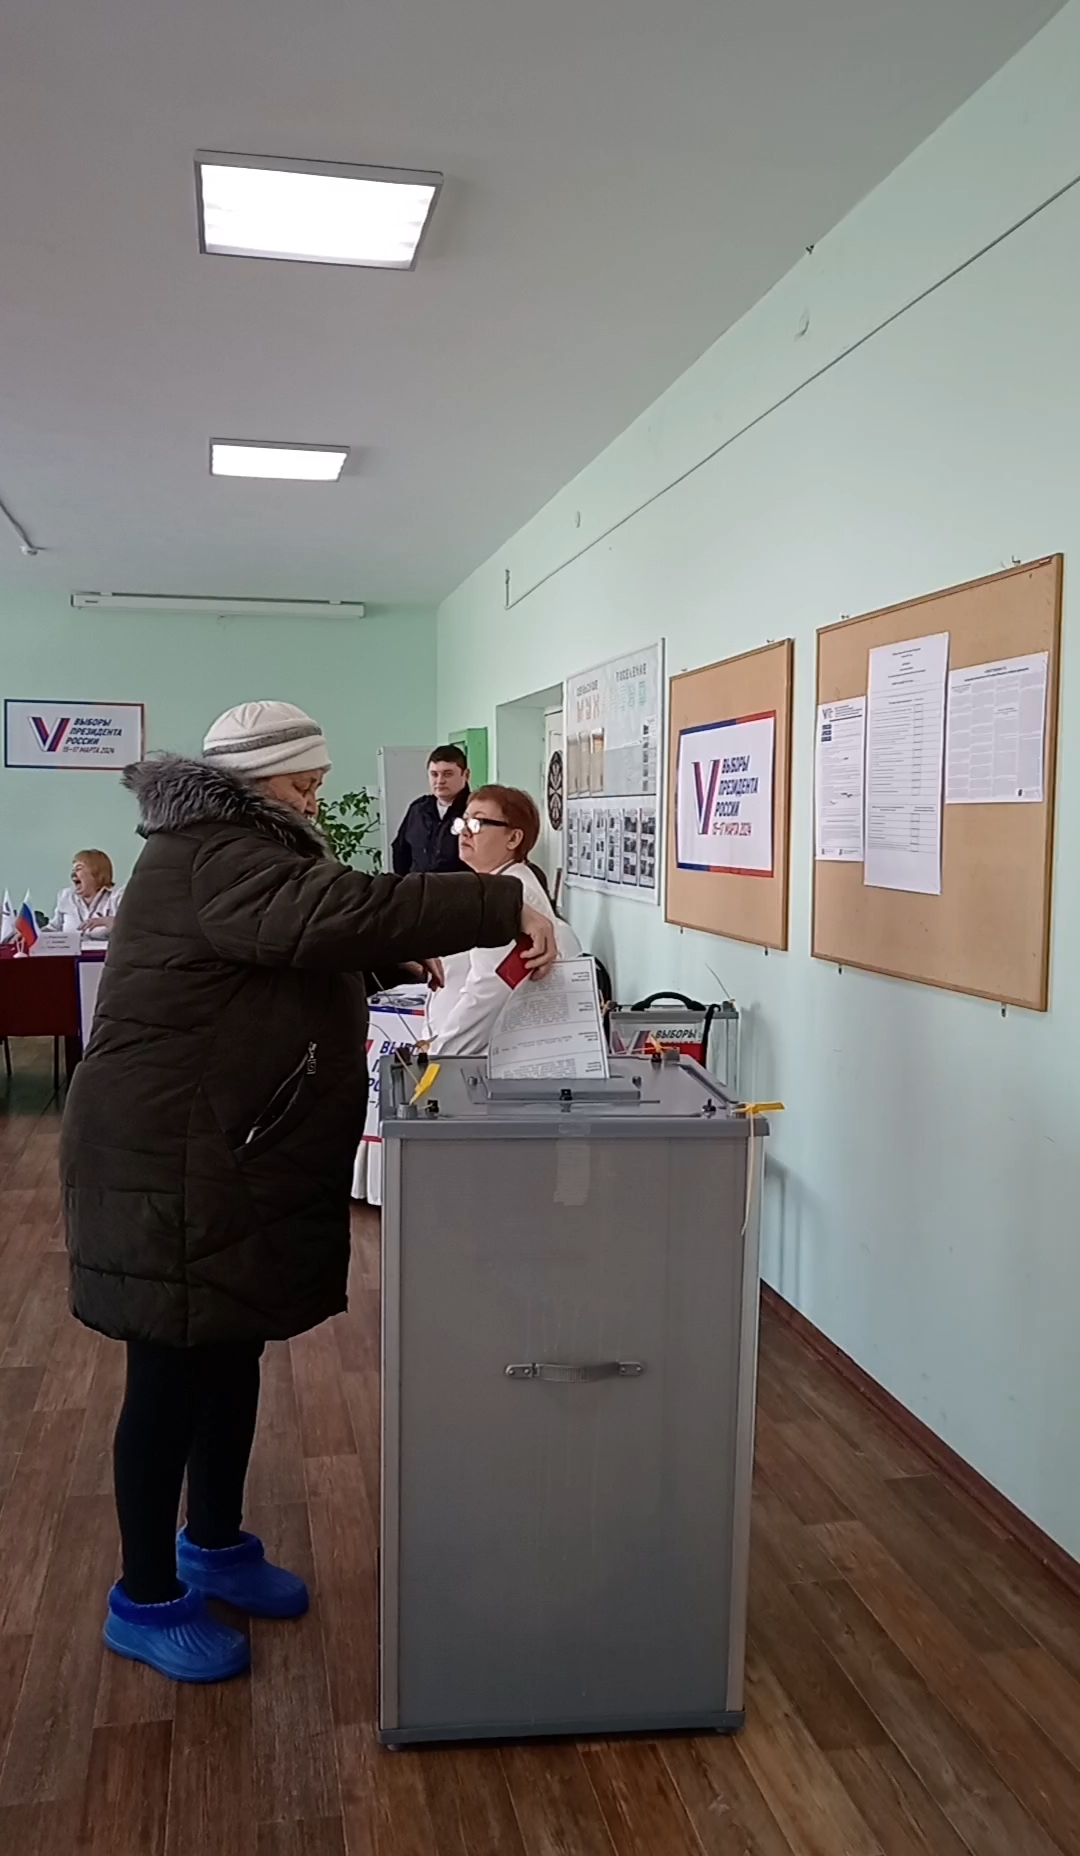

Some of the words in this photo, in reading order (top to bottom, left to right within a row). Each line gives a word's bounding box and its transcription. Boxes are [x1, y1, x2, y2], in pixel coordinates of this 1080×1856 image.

[73, 717, 112, 726] ВЫБОРЫ
[69, 727, 122, 737] ПРЕЗИДЕНТА
[65, 737, 100, 745] РОССИИ
[721, 755, 750, 774] ВЫБОРЫ
[718, 777, 759, 797] ПРЕЗИДЕНТА
[714, 801, 740, 817] РОССИИ
[655, 1029, 697, 1039] ВЫБОРЫ
